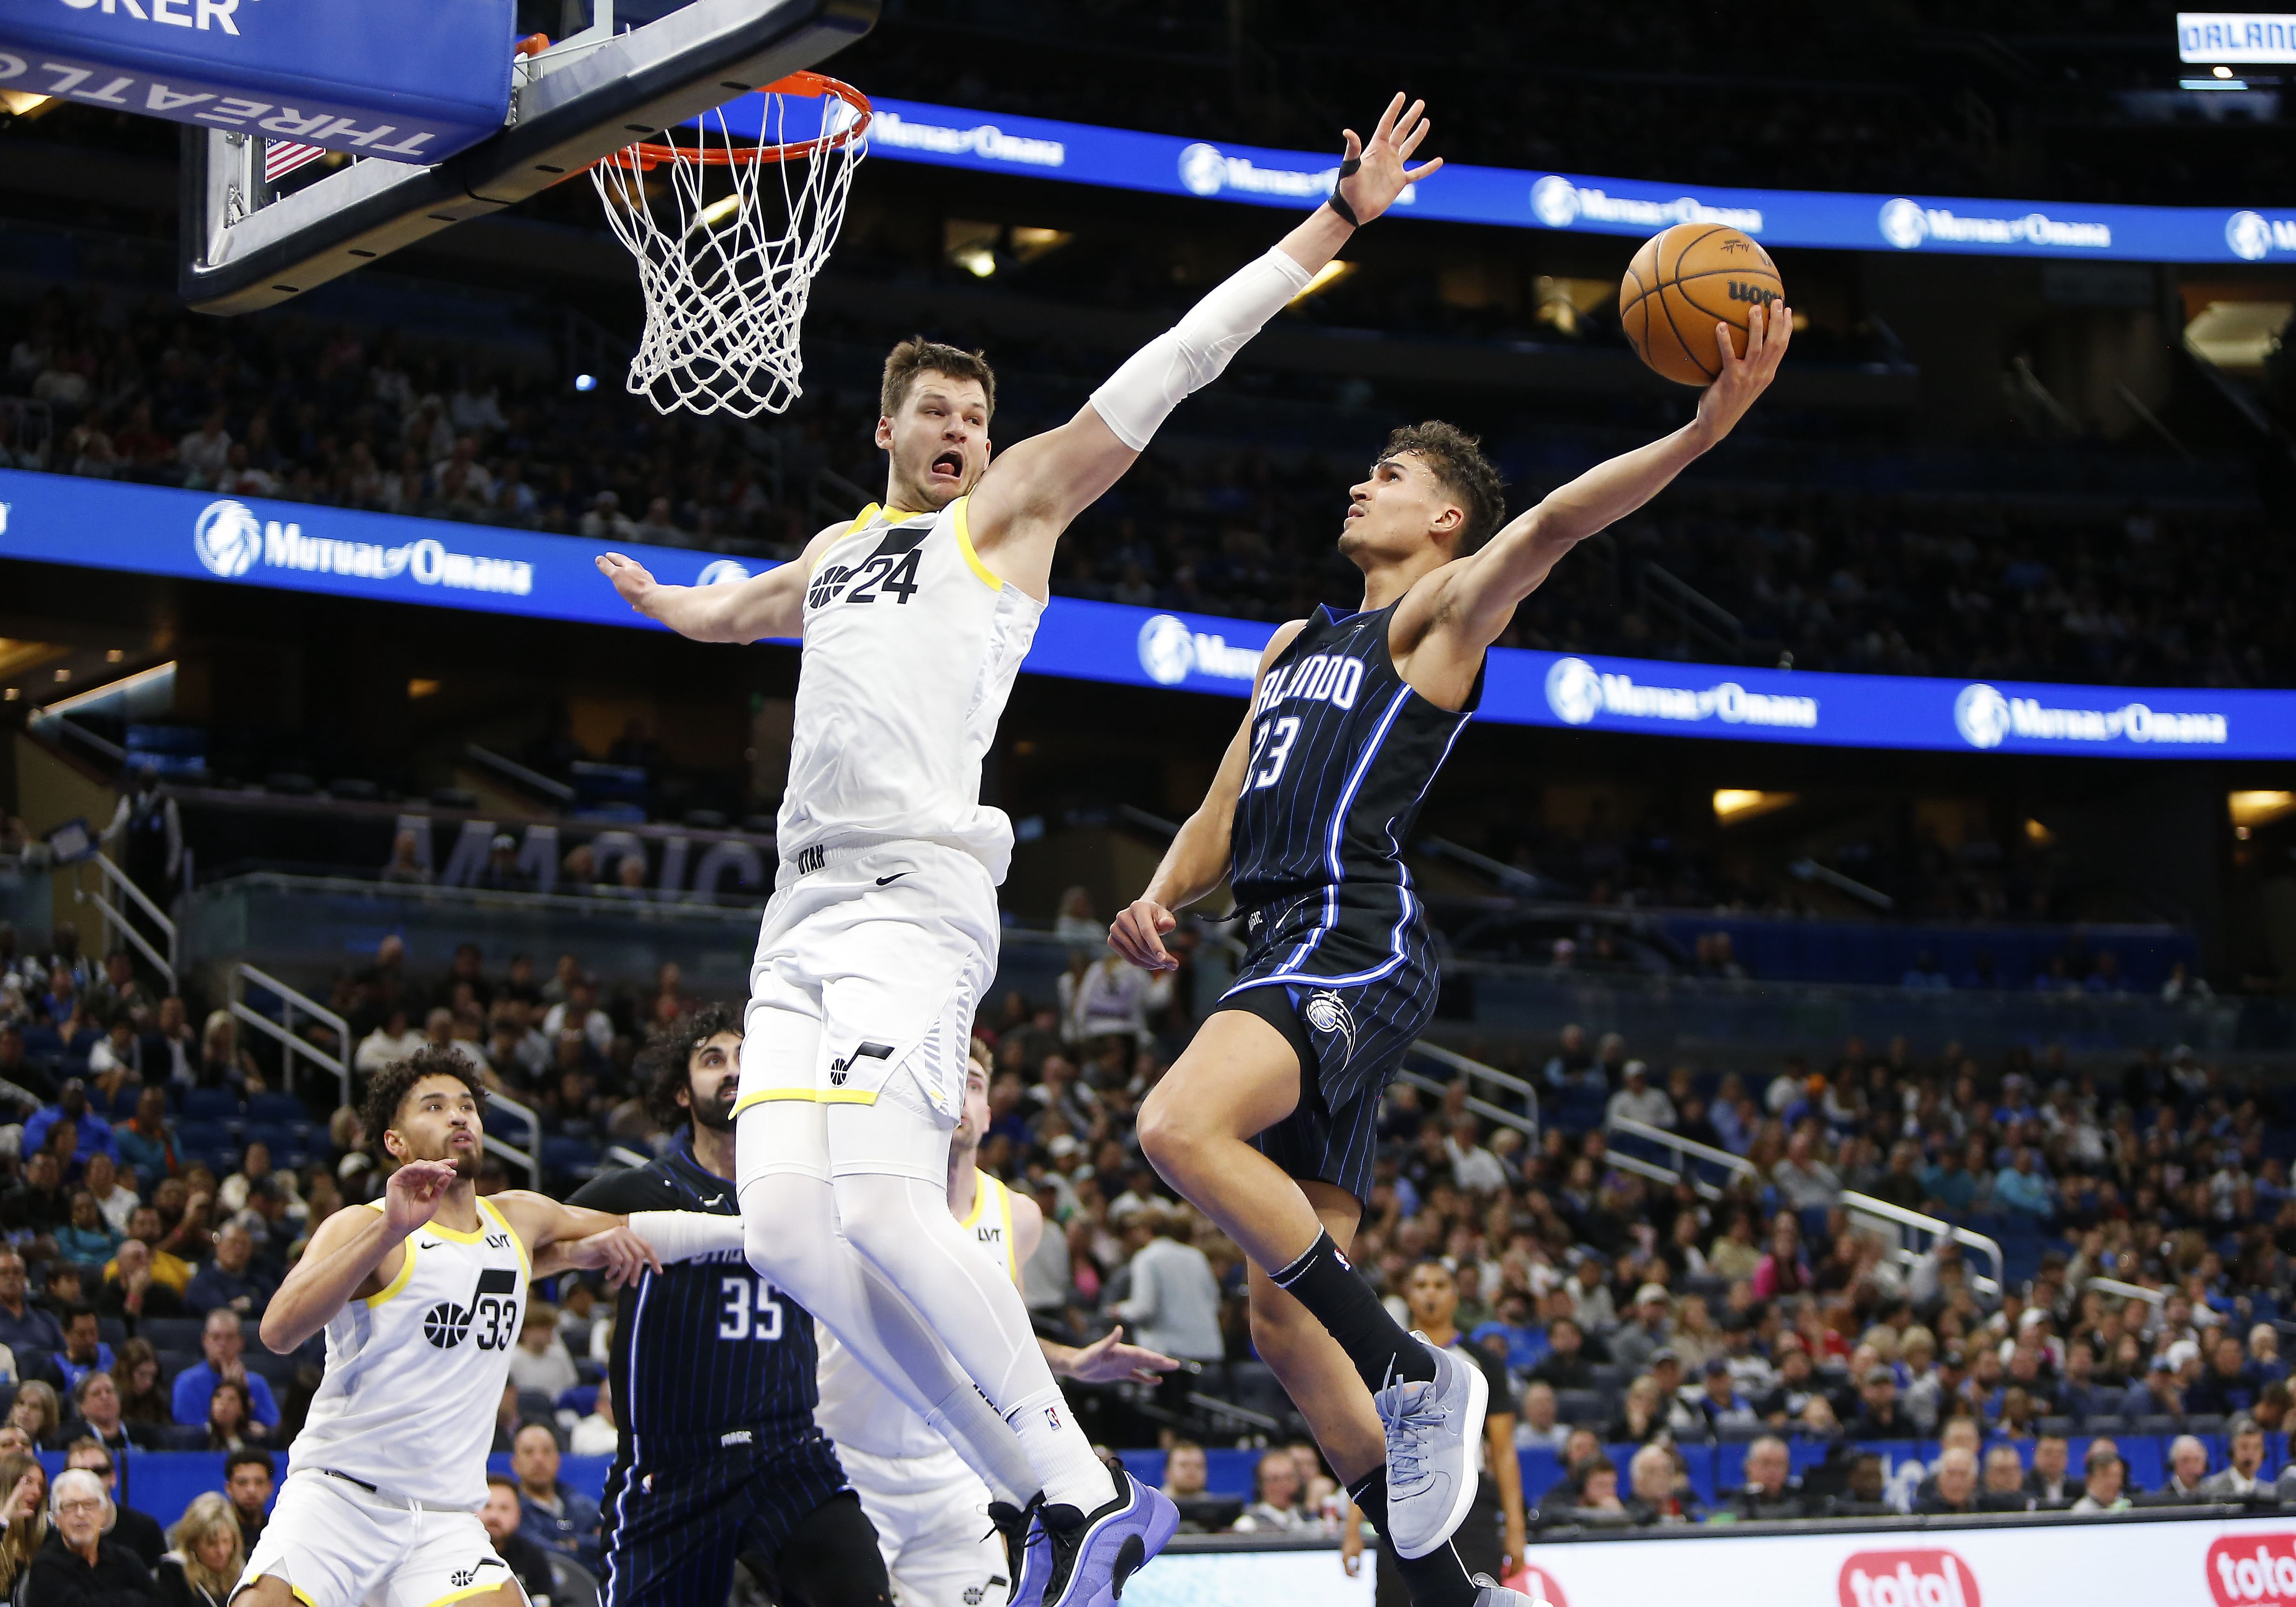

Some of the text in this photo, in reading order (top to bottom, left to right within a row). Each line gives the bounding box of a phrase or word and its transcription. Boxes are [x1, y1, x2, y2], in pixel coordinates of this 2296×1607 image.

[846, 548, 923, 604] 24
[1253, 654, 1365, 722] RLANDO
[1239, 716, 1302, 799] 23
[798, 844, 825, 875] UTAH
[485, 1233, 510, 1248] LVT
[978, 1228, 1000, 1242] LVT
[477, 1296, 517, 1351] 33
[719, 1277, 783, 1340] 35
